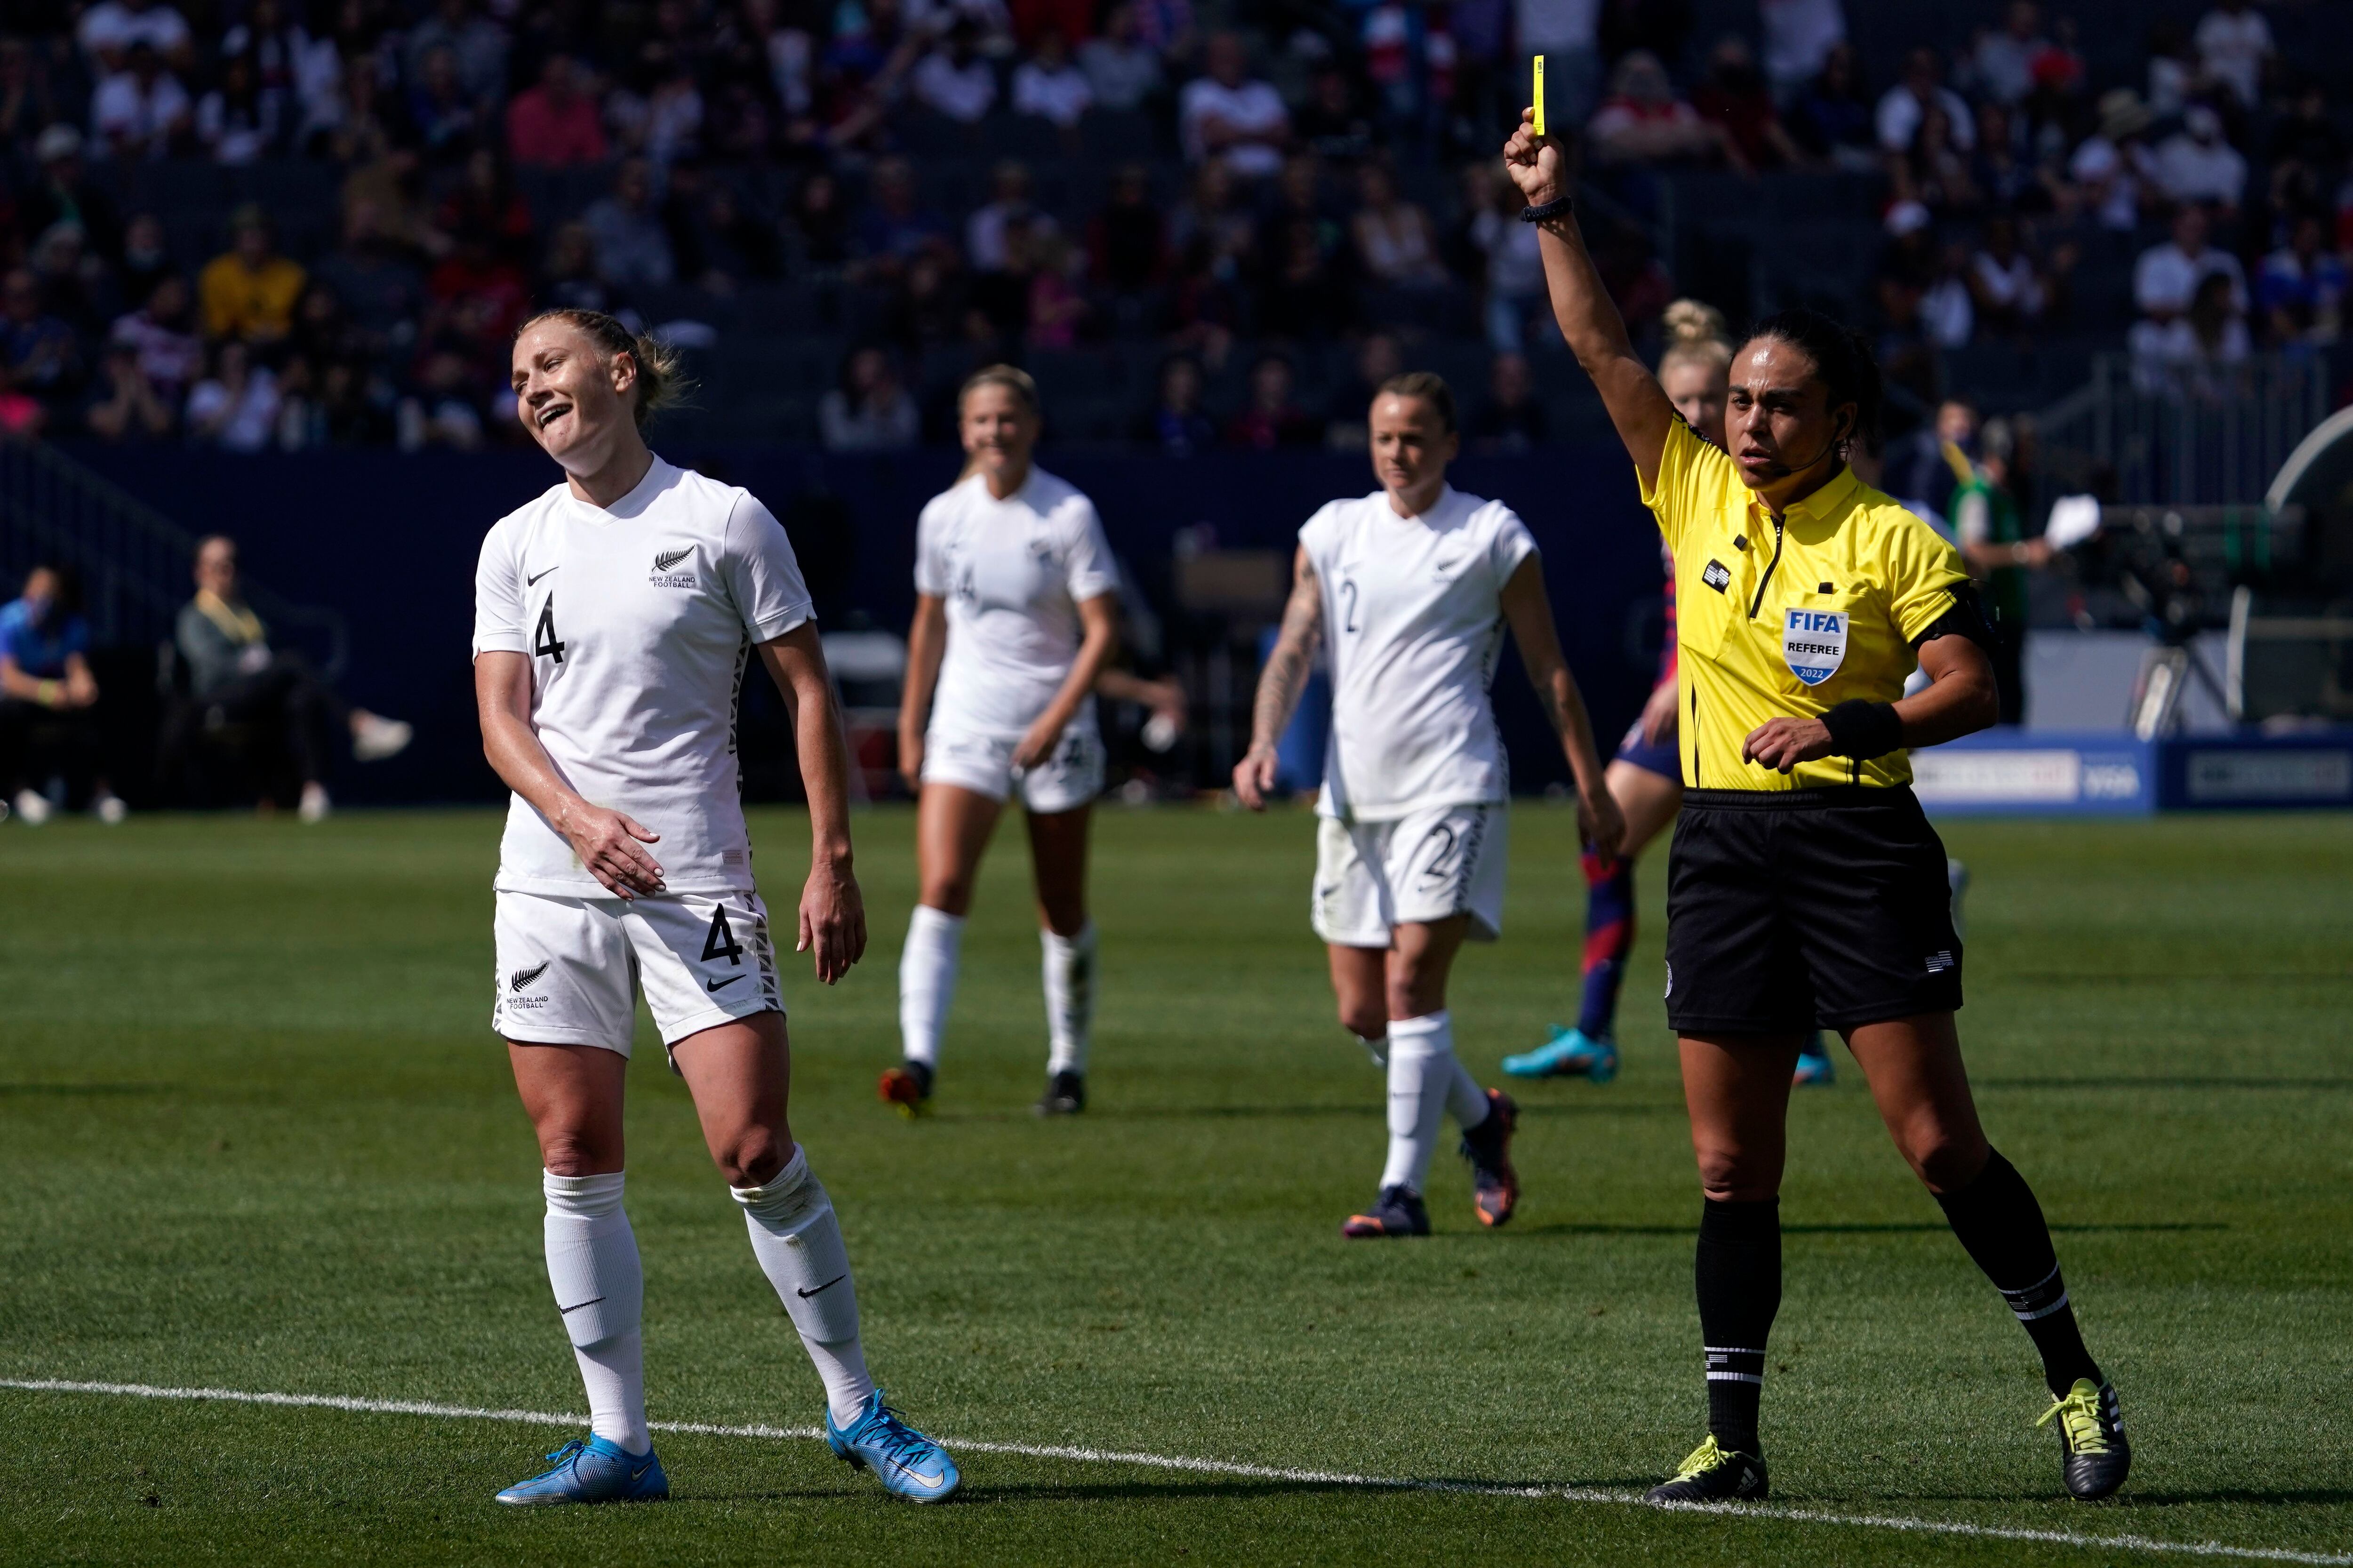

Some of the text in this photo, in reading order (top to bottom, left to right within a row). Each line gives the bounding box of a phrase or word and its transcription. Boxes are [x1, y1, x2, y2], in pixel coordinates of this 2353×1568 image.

[535, 589, 565, 664] 4
[1340, 576, 1359, 632] 2
[1790, 611, 1841, 633] FIFA
[1788, 642, 1840, 656] REFEREE
[1800, 668, 1824, 678] 2022
[1423, 822, 1454, 877] 2
[700, 903, 743, 966] 4
